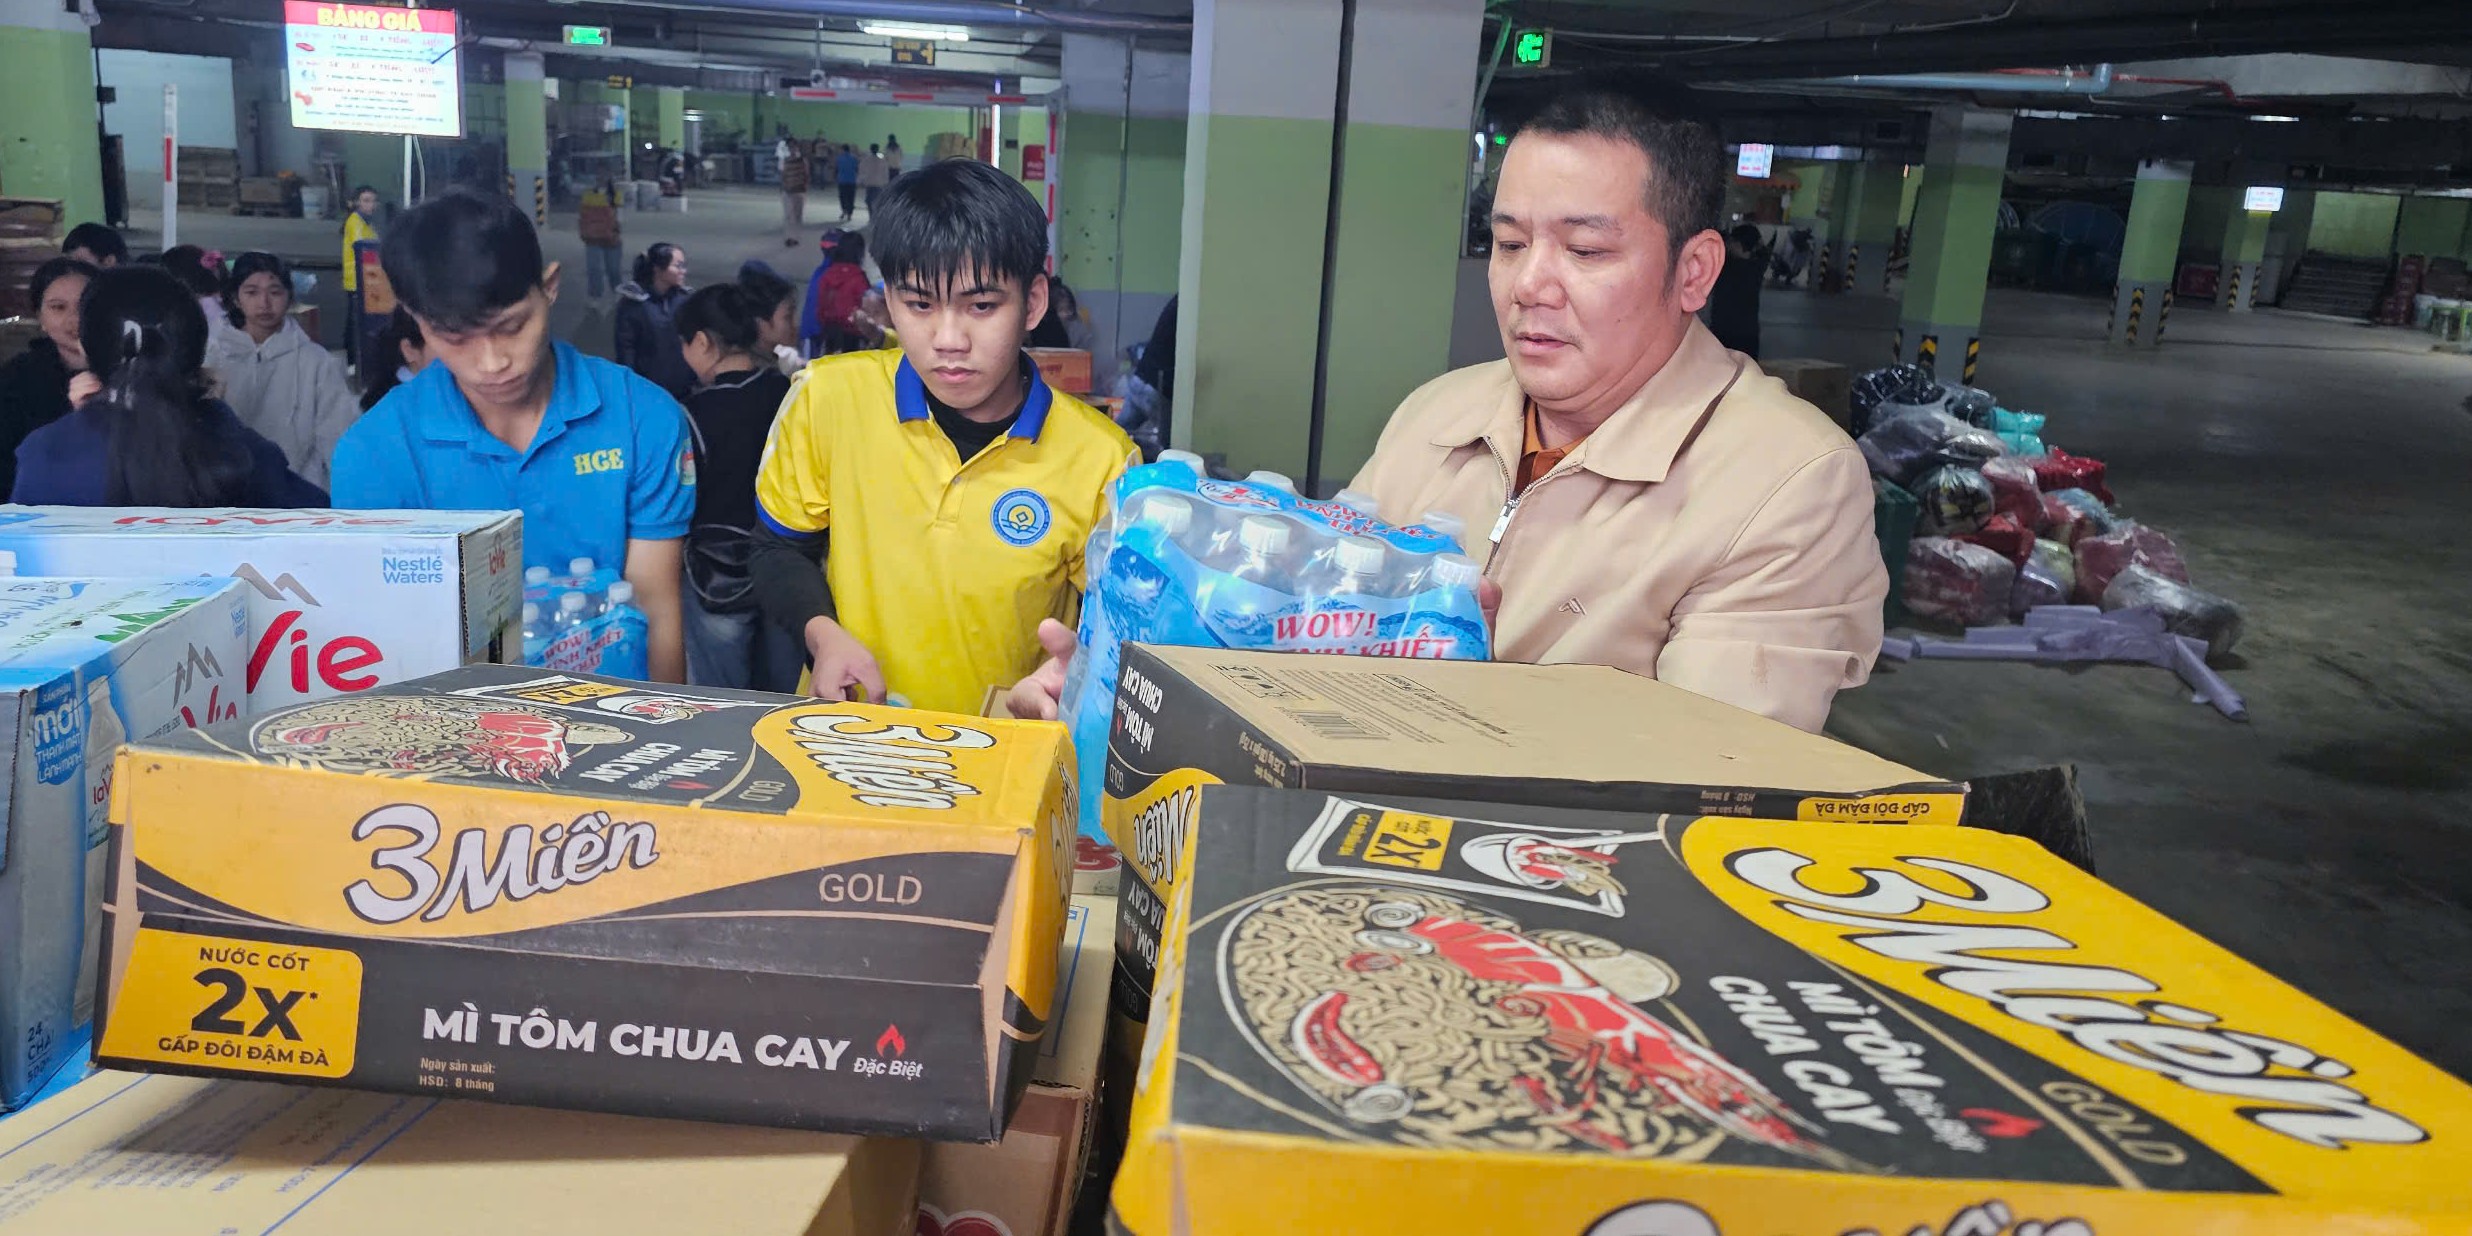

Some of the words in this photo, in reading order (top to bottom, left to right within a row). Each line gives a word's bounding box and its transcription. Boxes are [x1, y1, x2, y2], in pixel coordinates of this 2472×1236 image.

[573, 447, 624, 475] HCE
[383, 556, 443, 571] Nestlé
[383, 571, 443, 584] Waters
[1276, 612, 1376, 641] WOW!
[1815, 803, 1836, 817] ĐÀ
[1839, 800, 1870, 815] ĐẬM
[1873, 803, 1899, 816] ĐÔI
[1902, 802, 1930, 818] GẤP
[819, 873, 923, 904] GOLD
[200, 946, 261, 967] NƯỚC
[267, 948, 311, 972] CỐT
[157, 1034, 200, 1054] GẤP
[204, 1041, 242, 1058] ĐÔI
[247, 1043, 294, 1068] ĐẬM
[299, 1045, 330, 1067] ĐÀ
[423, 1001, 479, 1044] MÌ
[491, 1005, 595, 1053] TÔM
[609, 1023, 742, 1064] CHUA
[754, 1034, 852, 1072] CAY
[852, 1057, 887, 1079] Đặc
[888, 1060, 924, 1081] Biệt
[1825, 1018, 1946, 1088] TÔM
[420, 1057, 447, 1072] Ngày
[449, 1059, 468, 1072] sản
[1708, 975, 1822, 1056] CHUA
[1782, 1059, 1903, 1135] CAY
[419, 1074, 448, 1088] HSD:
[455, 1077, 462, 1088] 8
[465, 1078, 495, 1092] tháng
[2039, 1080, 2190, 1167] GOLD
